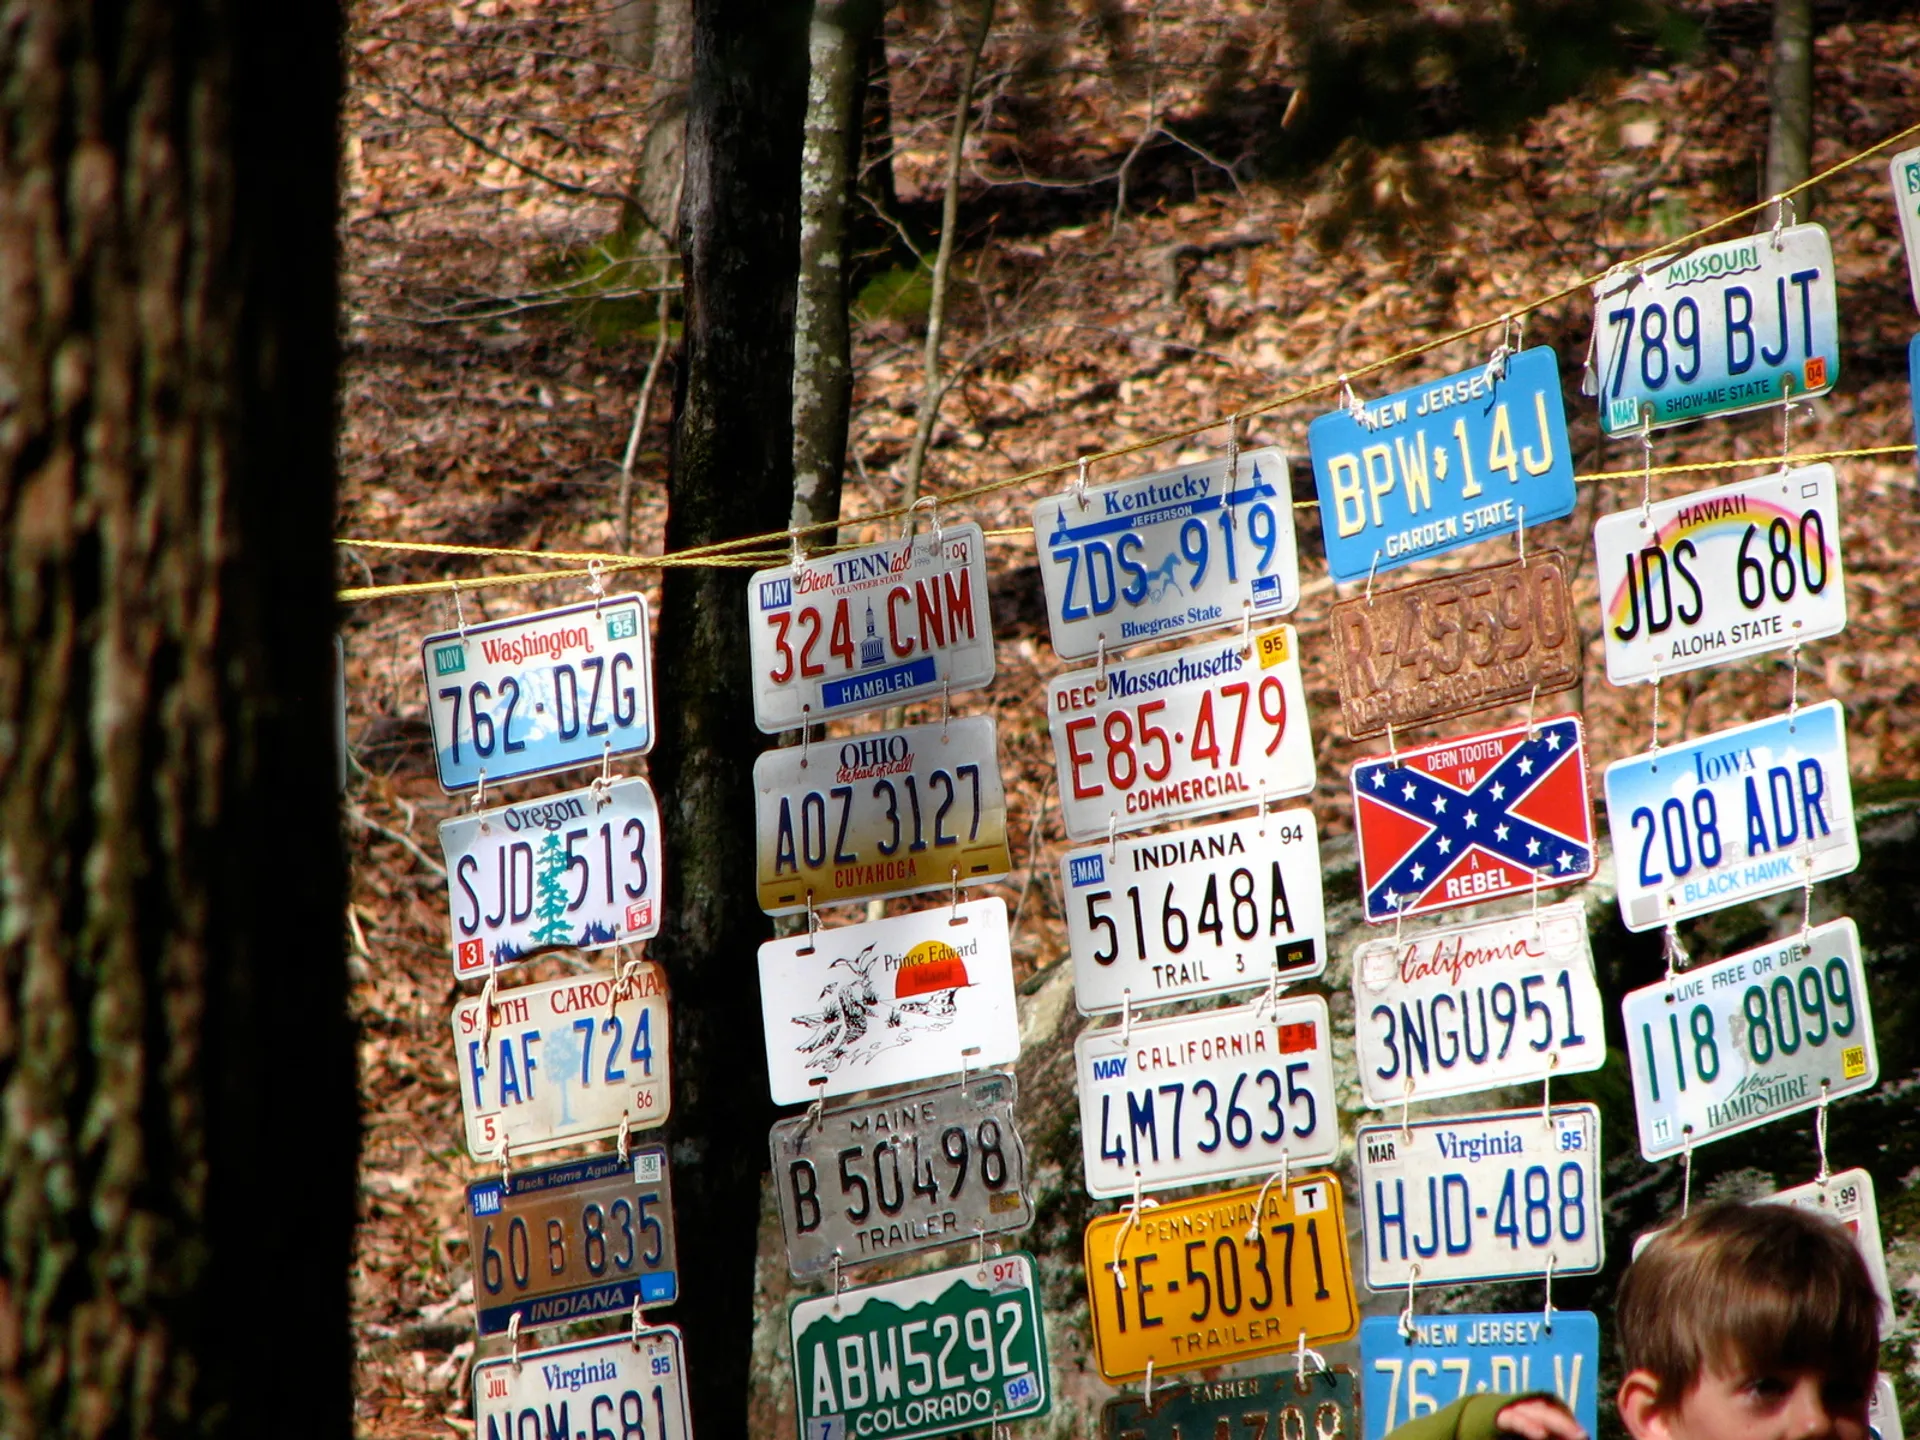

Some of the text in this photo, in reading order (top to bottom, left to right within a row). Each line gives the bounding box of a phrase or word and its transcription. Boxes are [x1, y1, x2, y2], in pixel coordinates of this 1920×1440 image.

[1668, 246, 1758, 284] MISSOURI
[1609, 267, 1819, 397] 789 BJT
[1612, 401, 1636, 425] MAR
[1667, 380, 1770, 413] SHOW-ME STATE
[1365, 398, 1407, 433] NEW
[1103, 475, 1210, 515] Kentucky
[1678, 494, 1747, 529] HAWAII
[1131, 505, 1192, 527] JEFFERSON
[1386, 499, 1515, 557] GARDEN STATE
[1053, 502, 1276, 621] ZDS 919
[1614, 509, 1826, 641] JDS 680
[763, 580, 789, 607] MAY
[831, 574, 904, 595] VOLUNTEER STATE
[613, 620, 632, 637] 95
[768, 568, 975, 683] 324 CNM
[1121, 606, 1222, 638] Bluegrass State
[1671, 615, 1782, 659] ALOHA STATE
[438, 650, 460, 671] NOV
[481, 627, 594, 665] Washington
[1263, 636, 1283, 653] 95
[842, 671, 914, 703] HAMBLEN
[1108, 649, 1242, 699] Massachusetts
[1057, 686, 1096, 711] DEC
[840, 735, 908, 769] OHIO
[1427, 740, 1504, 771] DERN TOOTEN
[1127, 772, 1249, 813] COMMERCIAL
[1458, 768, 1475, 785] I'M
[504, 798, 585, 832] Oregon
[873, 764, 979, 855] 3127
[1631, 758, 1830, 887] 208 ADR
[1281, 824, 1303, 844] 94
[1133, 832, 1245, 872] INDIANA
[1470, 854, 1479, 870] A
[457, 818, 648, 935] SJD 513
[835, 859, 916, 888] CUYAHOGA
[1077, 859, 1101, 882] MAR
[1446, 868, 1511, 898] REBEL
[1684, 856, 1794, 903] BLACK HAWK
[633, 911, 647, 926] 96
[1086, 861, 1294, 965] 51648A
[466, 943, 477, 964] 3
[884, 939, 978, 972] Prince Edward
[1235, 954, 1244, 972] 3
[1401, 937, 1544, 986] California
[1152, 961, 1210, 988] TRAIL
[1677, 945, 1802, 1002] LIVE FREE OR DIE
[551, 972, 660, 1014] CARONA
[1371, 970, 1585, 1080] 3NGU951
[1643, 957, 1855, 1102] 118 8099
[469, 1008, 651, 1110] FAF 724
[1137, 1030, 1266, 1070] CALIFORNIA
[1094, 1058, 1127, 1080] MAY
[637, 1091, 652, 1108] 86
[1707, 1074, 1810, 1128] HAMPSHIRE
[1722, 1072, 1787, 1101] New
[485, 1118, 495, 1141] 5
[851, 1102, 934, 1133] MAINE
[1101, 1062, 1316, 1167] 4M73635
[1654, 1120, 1669, 1139] 11
[1368, 1144, 1395, 1164] MAR
[1436, 1131, 1523, 1162] Virginia
[1561, 1132, 1582, 1150] 95
[517, 1163, 617, 1191] Back Home Again
[790, 1119, 1007, 1233] B 50498
[479, 1191, 498, 1212] MAR
[1302, 1188, 1317, 1208] T
[1840, 1187, 1856, 1203] 99
[482, 1194, 663, 1294] 60 B 835
[855, 1212, 958, 1252] TRAILER
[994, 1262, 1014, 1282] 97
[530, 1288, 624, 1321] INDIANA
[1171, 1317, 1281, 1355] TRAILER
[1418, 1321, 1540, 1345] NEW JERSEY
[543, 1358, 617, 1392] Virginia
[651, 1356, 671, 1375] 95
[812, 1302, 1028, 1417] ABW5292
[488, 1379, 508, 1398] JUL
[1009, 1380, 1029, 1400] 98
[856, 1387, 991, 1437] COLORADO
